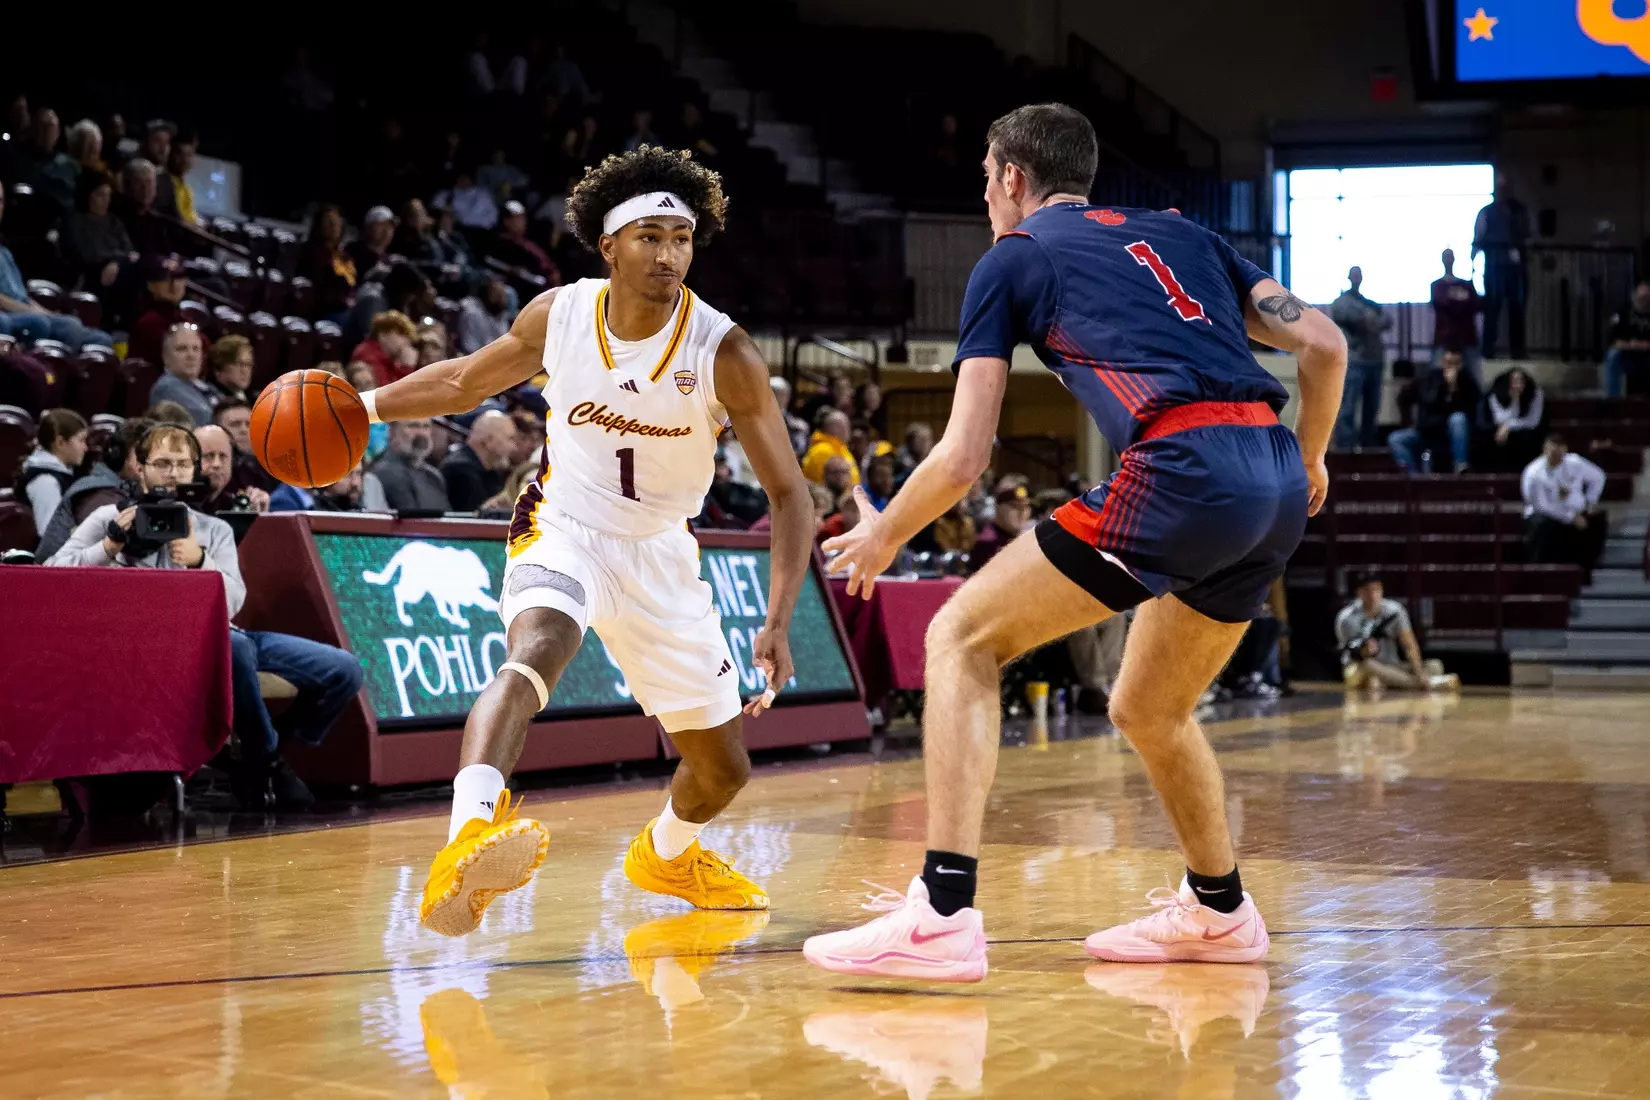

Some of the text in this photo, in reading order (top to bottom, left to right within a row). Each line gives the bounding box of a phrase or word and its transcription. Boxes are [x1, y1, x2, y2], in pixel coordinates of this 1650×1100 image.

[1125, 240, 1212, 325] 1
[567, 401, 692, 438] Chippewas
[615, 447, 641, 502] 1
[708, 555, 768, 617] NET
